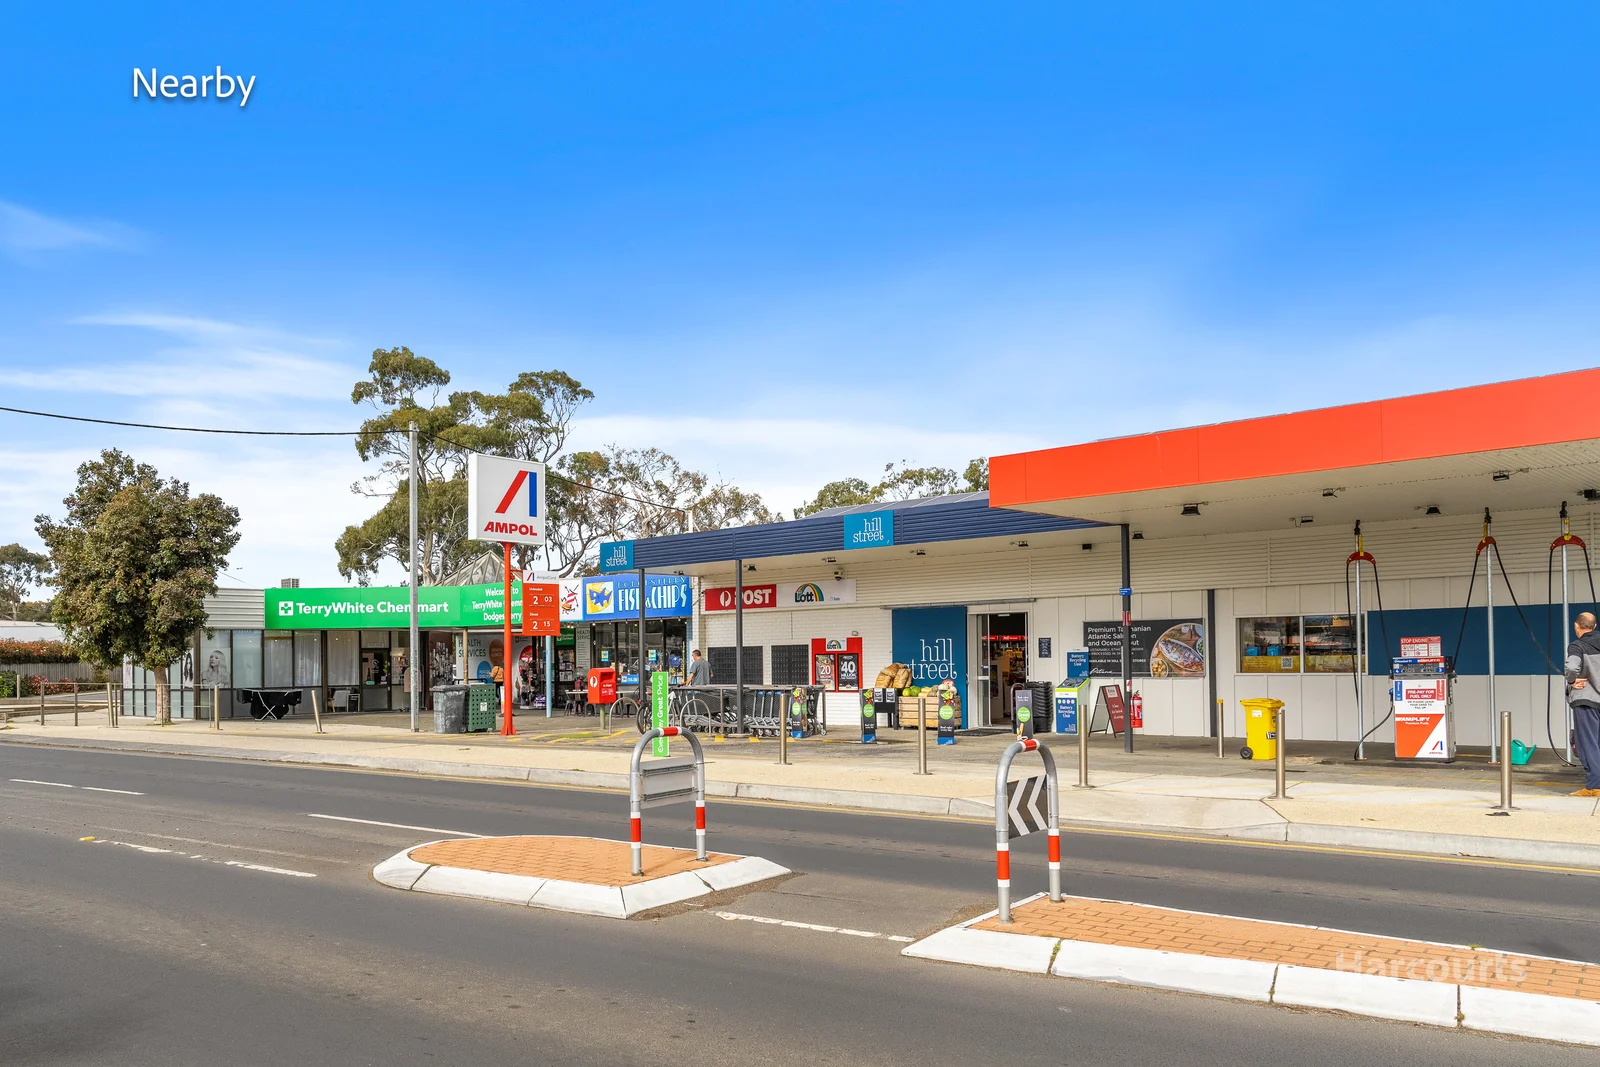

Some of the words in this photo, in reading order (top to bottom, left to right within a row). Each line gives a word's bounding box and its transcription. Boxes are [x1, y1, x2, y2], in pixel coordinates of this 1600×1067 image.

[484, 522, 538, 536] AMPOL
[864, 516, 882, 532] hill
[852, 530, 884, 543] street
[614, 546, 626, 558] hill
[606, 556, 628, 567] street
[533, 596, 538, 604] 2
[652, 584, 687, 609] CHIPS
[296, 602, 374, 616] TerryWhite
[472, 600, 502, 612] TerryWhite
[511, 613, 522, 622] erry
[532, 621, 538, 630] 2
[458, 639, 481, 647] HALTH
[458, 648, 486, 658] SEVICES
[920, 638, 952, 662] hill
